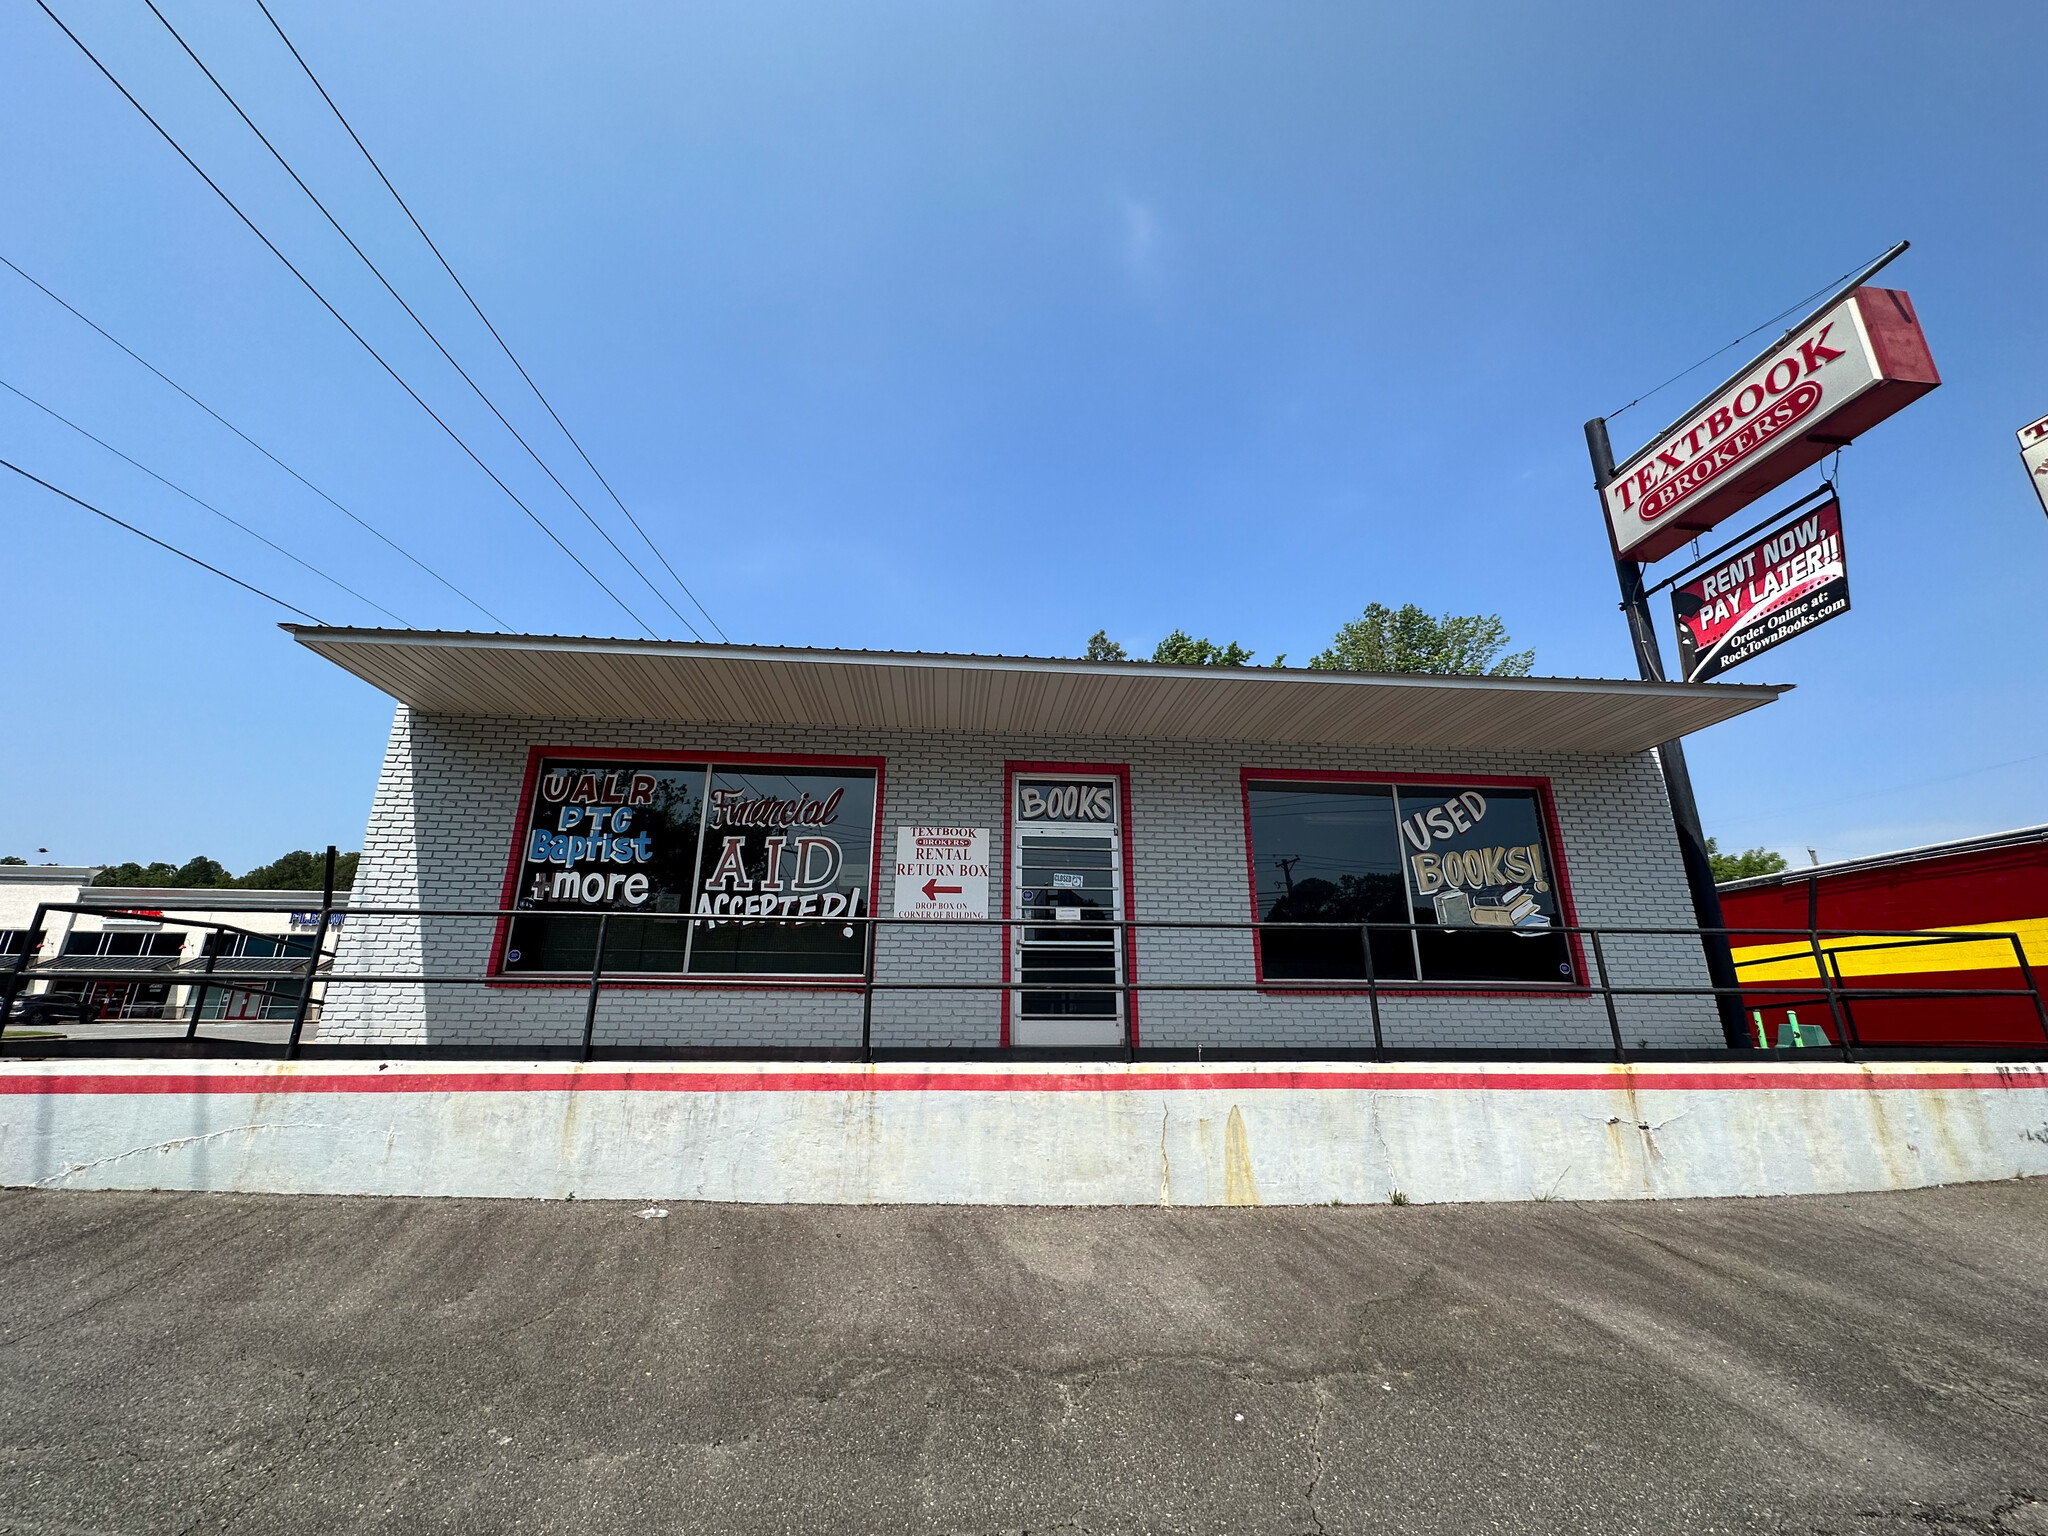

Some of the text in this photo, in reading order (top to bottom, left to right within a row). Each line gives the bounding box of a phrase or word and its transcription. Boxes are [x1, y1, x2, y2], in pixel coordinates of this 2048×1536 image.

[1614, 321, 1846, 514] TEXTBOOK
[1657, 401, 1793, 508] BROKERS
[1702, 515, 1827, 601] RENT NOW,
[1699, 534, 1841, 631] PAY LATER!!
[1720, 597, 1846, 668] RockTownBooks.com
[1730, 591, 1829, 648] Order Online at:
[543, 774, 657, 805] UALR
[709, 787, 845, 830] Financial
[1021, 785, 1111, 821] BOOKS
[558, 806, 632, 833] PTC
[910, 827, 977, 838] TEXTBOOK
[1401, 791, 1487, 851] USED
[528, 829, 653, 868] Baptist
[705, 836, 844, 891] AID
[916, 848, 971, 860] RENTAL
[1411, 843, 1549, 896] BOOKS!
[897, 864, 988, 877] RETURN BOX
[1054, 874, 1072, 883] CLOSED
[694, 887, 861, 938] ACCEPTED!
[915, 902, 937, 910] DROP
[946, 911, 984, 919] BUILDING
